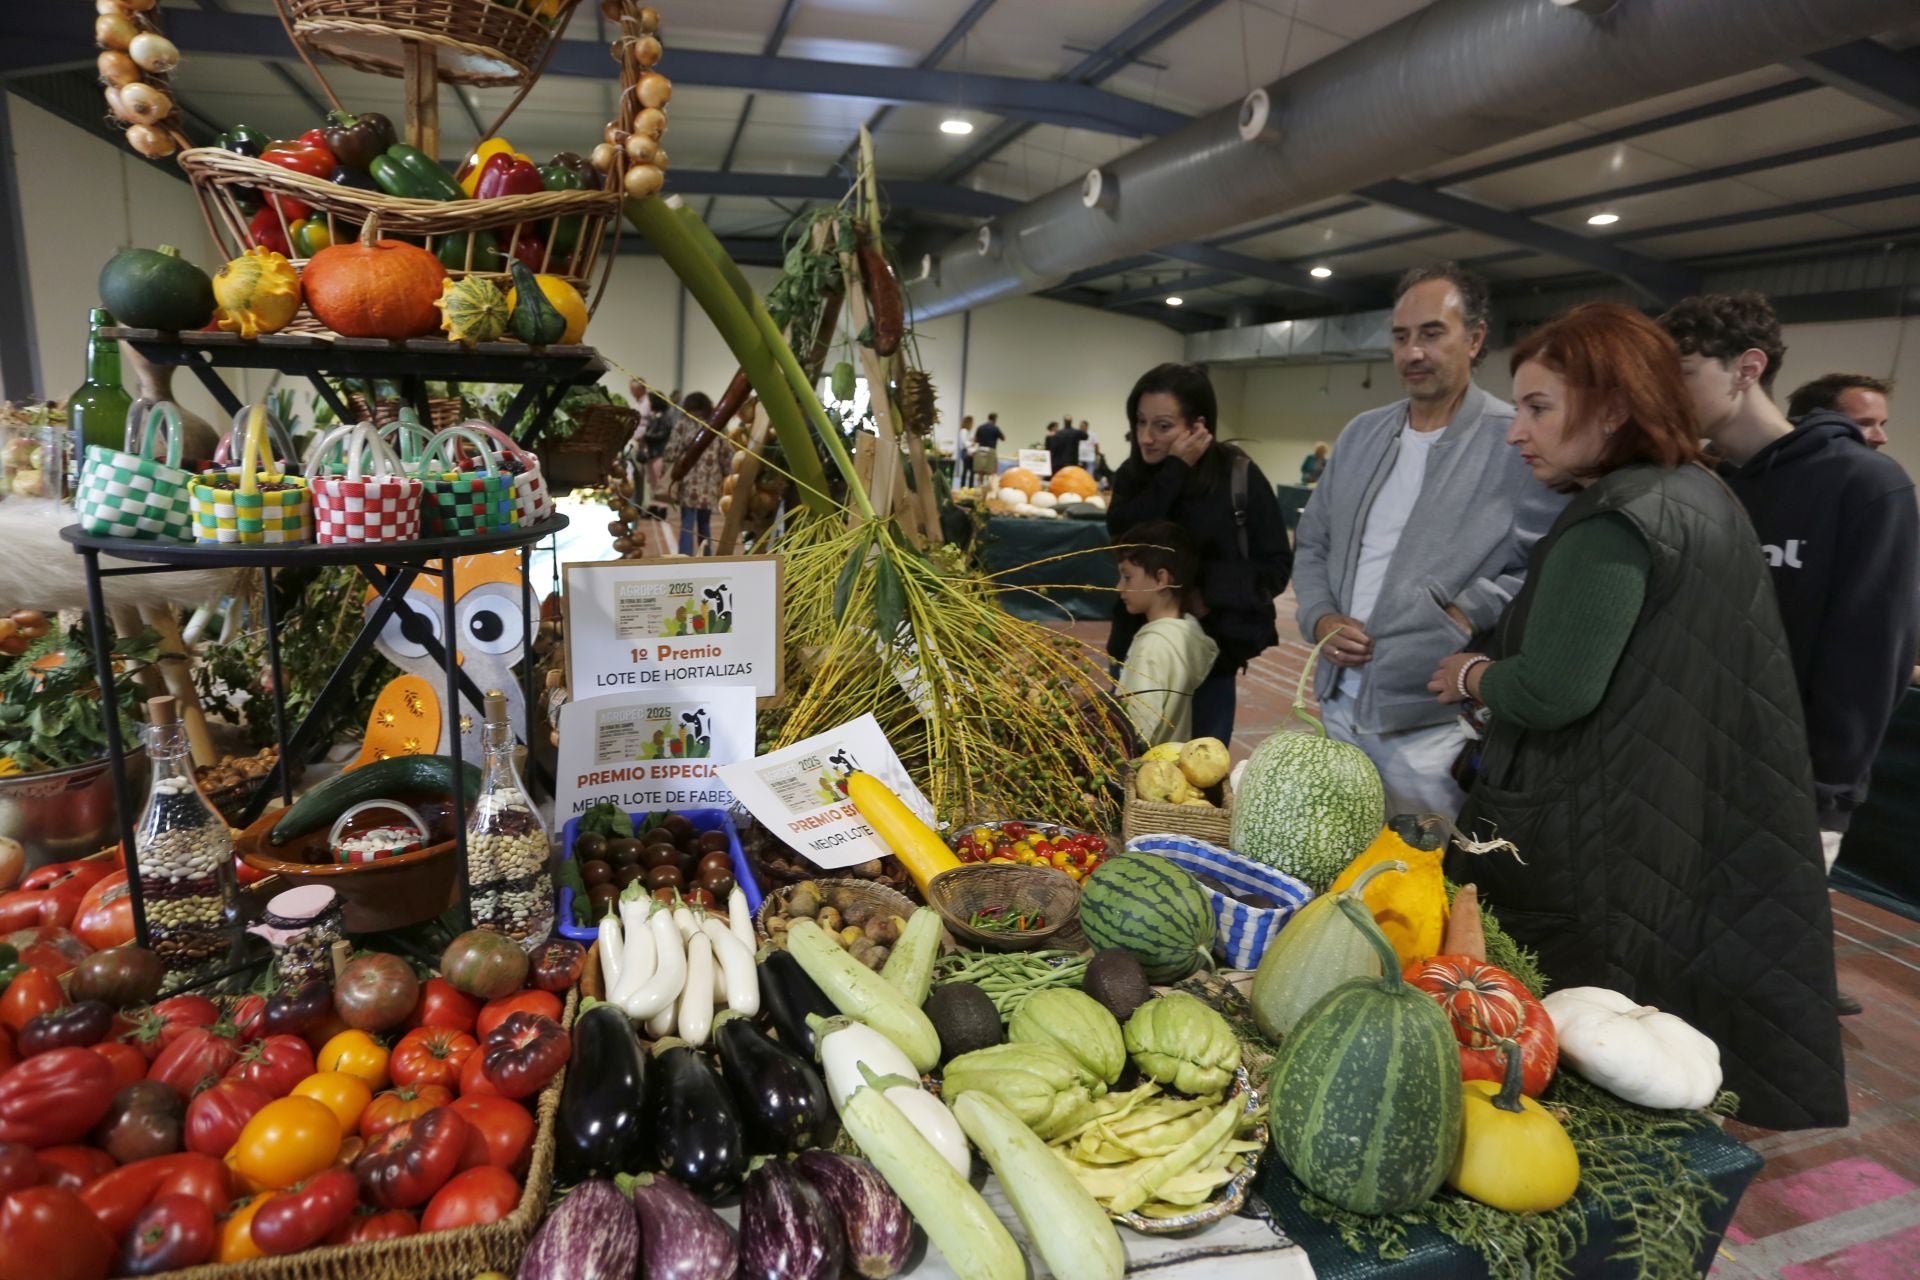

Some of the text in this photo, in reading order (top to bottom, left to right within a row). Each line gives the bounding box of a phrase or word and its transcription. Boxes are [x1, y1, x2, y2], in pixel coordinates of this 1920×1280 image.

[669, 582, 694, 595] 2025
[657, 644, 722, 662] Premio
[597, 662, 753, 687] LOTE DE HORTALIZAS
[646, 706, 672, 719] 2025
[798, 755, 822, 771] 2025
[577, 764, 722, 789] PREMIO ESPECIA
[624, 791, 661, 805] LOTE
[666, 790, 685, 803] DE
[689, 790, 733, 804] FABES
[786, 808, 843, 834] PREMIO
[844, 824, 874, 841] LOTE
